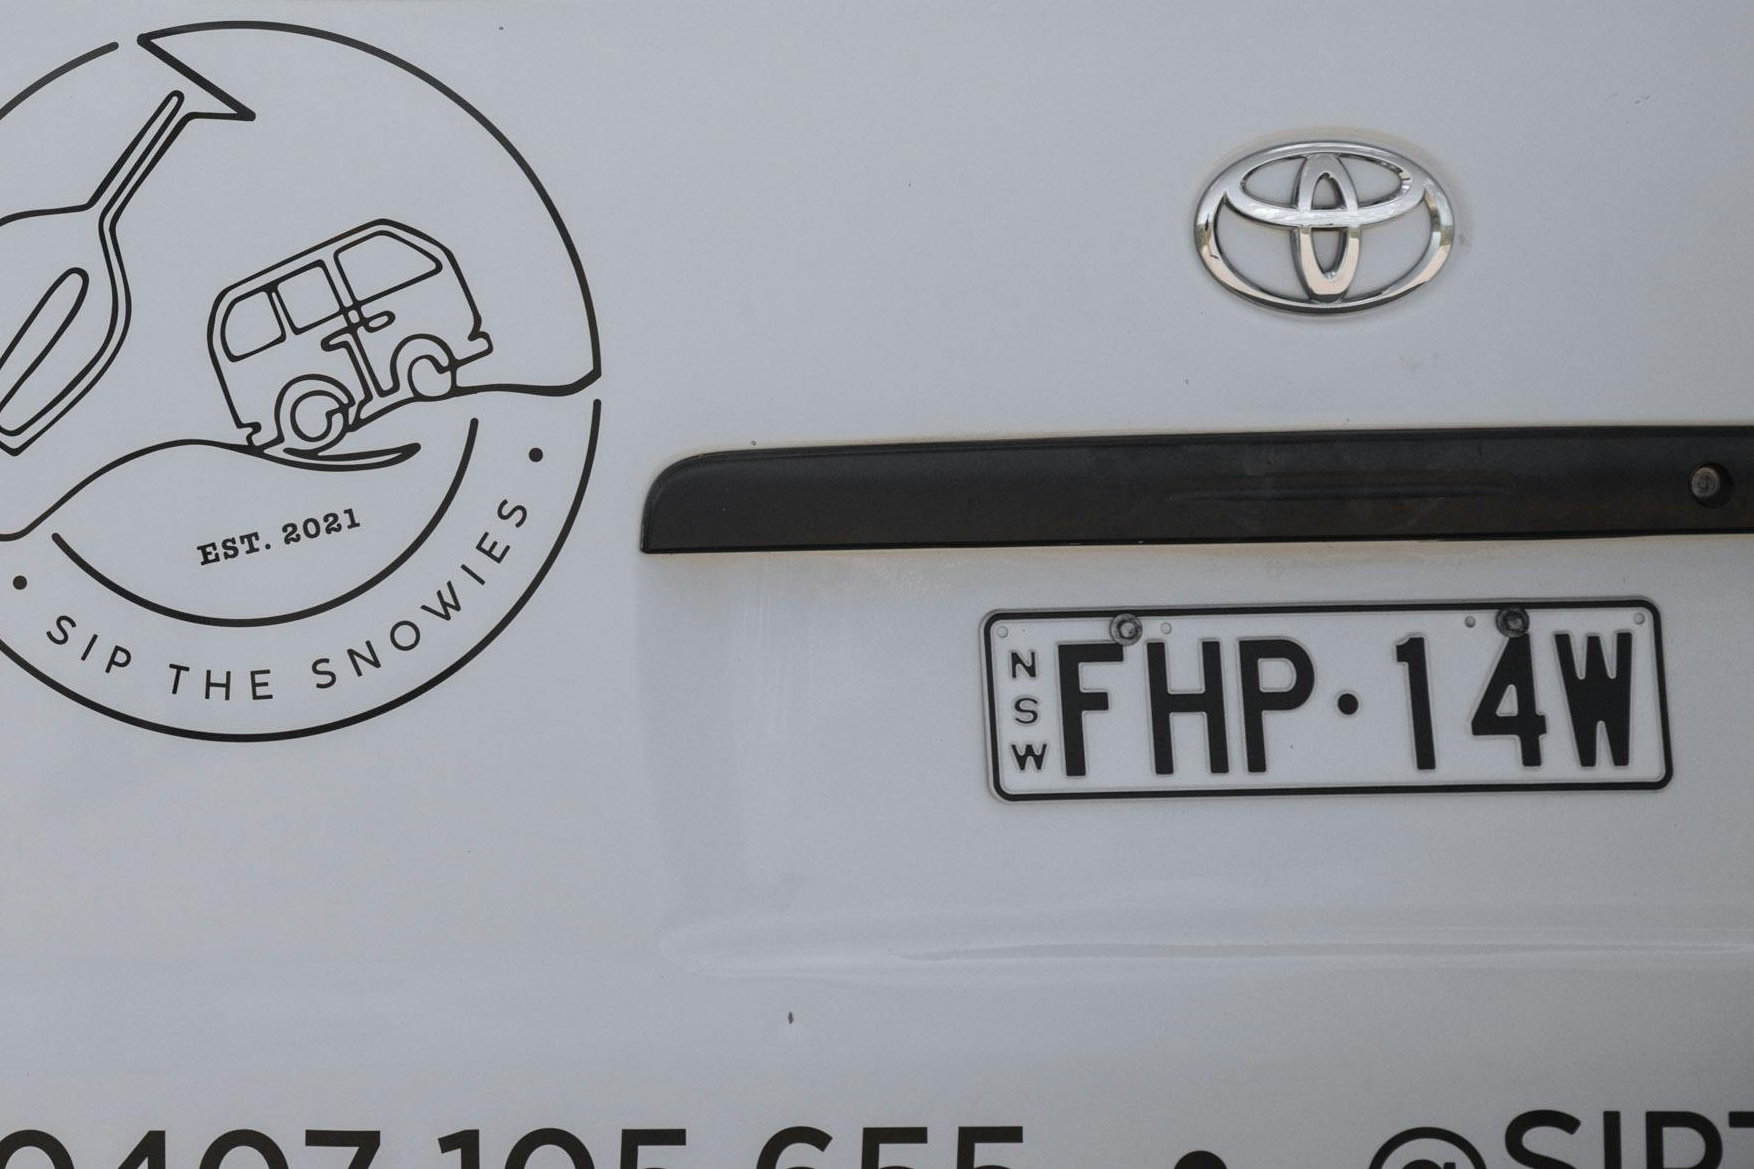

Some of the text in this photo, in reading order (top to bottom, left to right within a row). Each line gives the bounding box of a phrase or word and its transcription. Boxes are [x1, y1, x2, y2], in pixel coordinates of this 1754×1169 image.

[197, 509, 361, 566] EST. 2021
[46, 498, 528, 701] SIP THE SNOWIES
[1010, 651, 1048, 771] NSW
